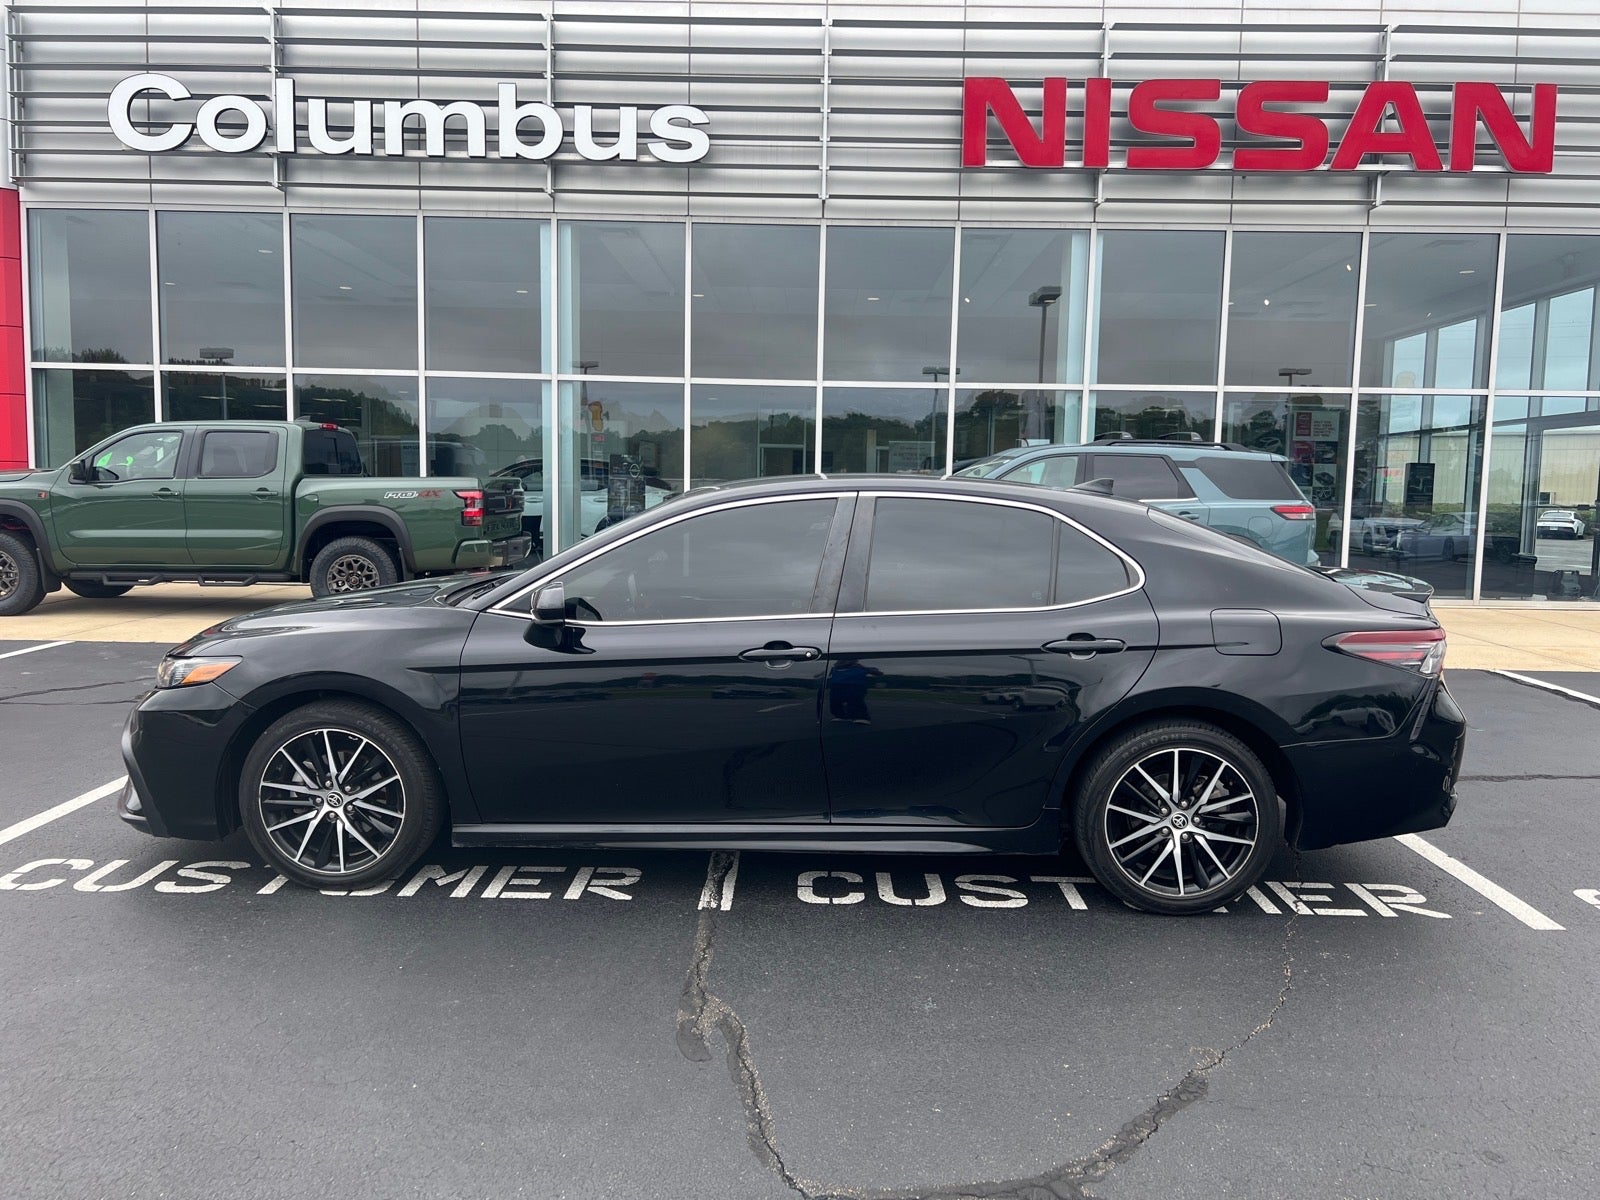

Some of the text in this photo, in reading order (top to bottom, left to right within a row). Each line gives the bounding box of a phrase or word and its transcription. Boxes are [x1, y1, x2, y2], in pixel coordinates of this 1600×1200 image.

[107, 72, 711, 163] Columbus
[962, 77, 1557, 174] NISSAN
[1121, 733, 1189, 759] ROADONE
